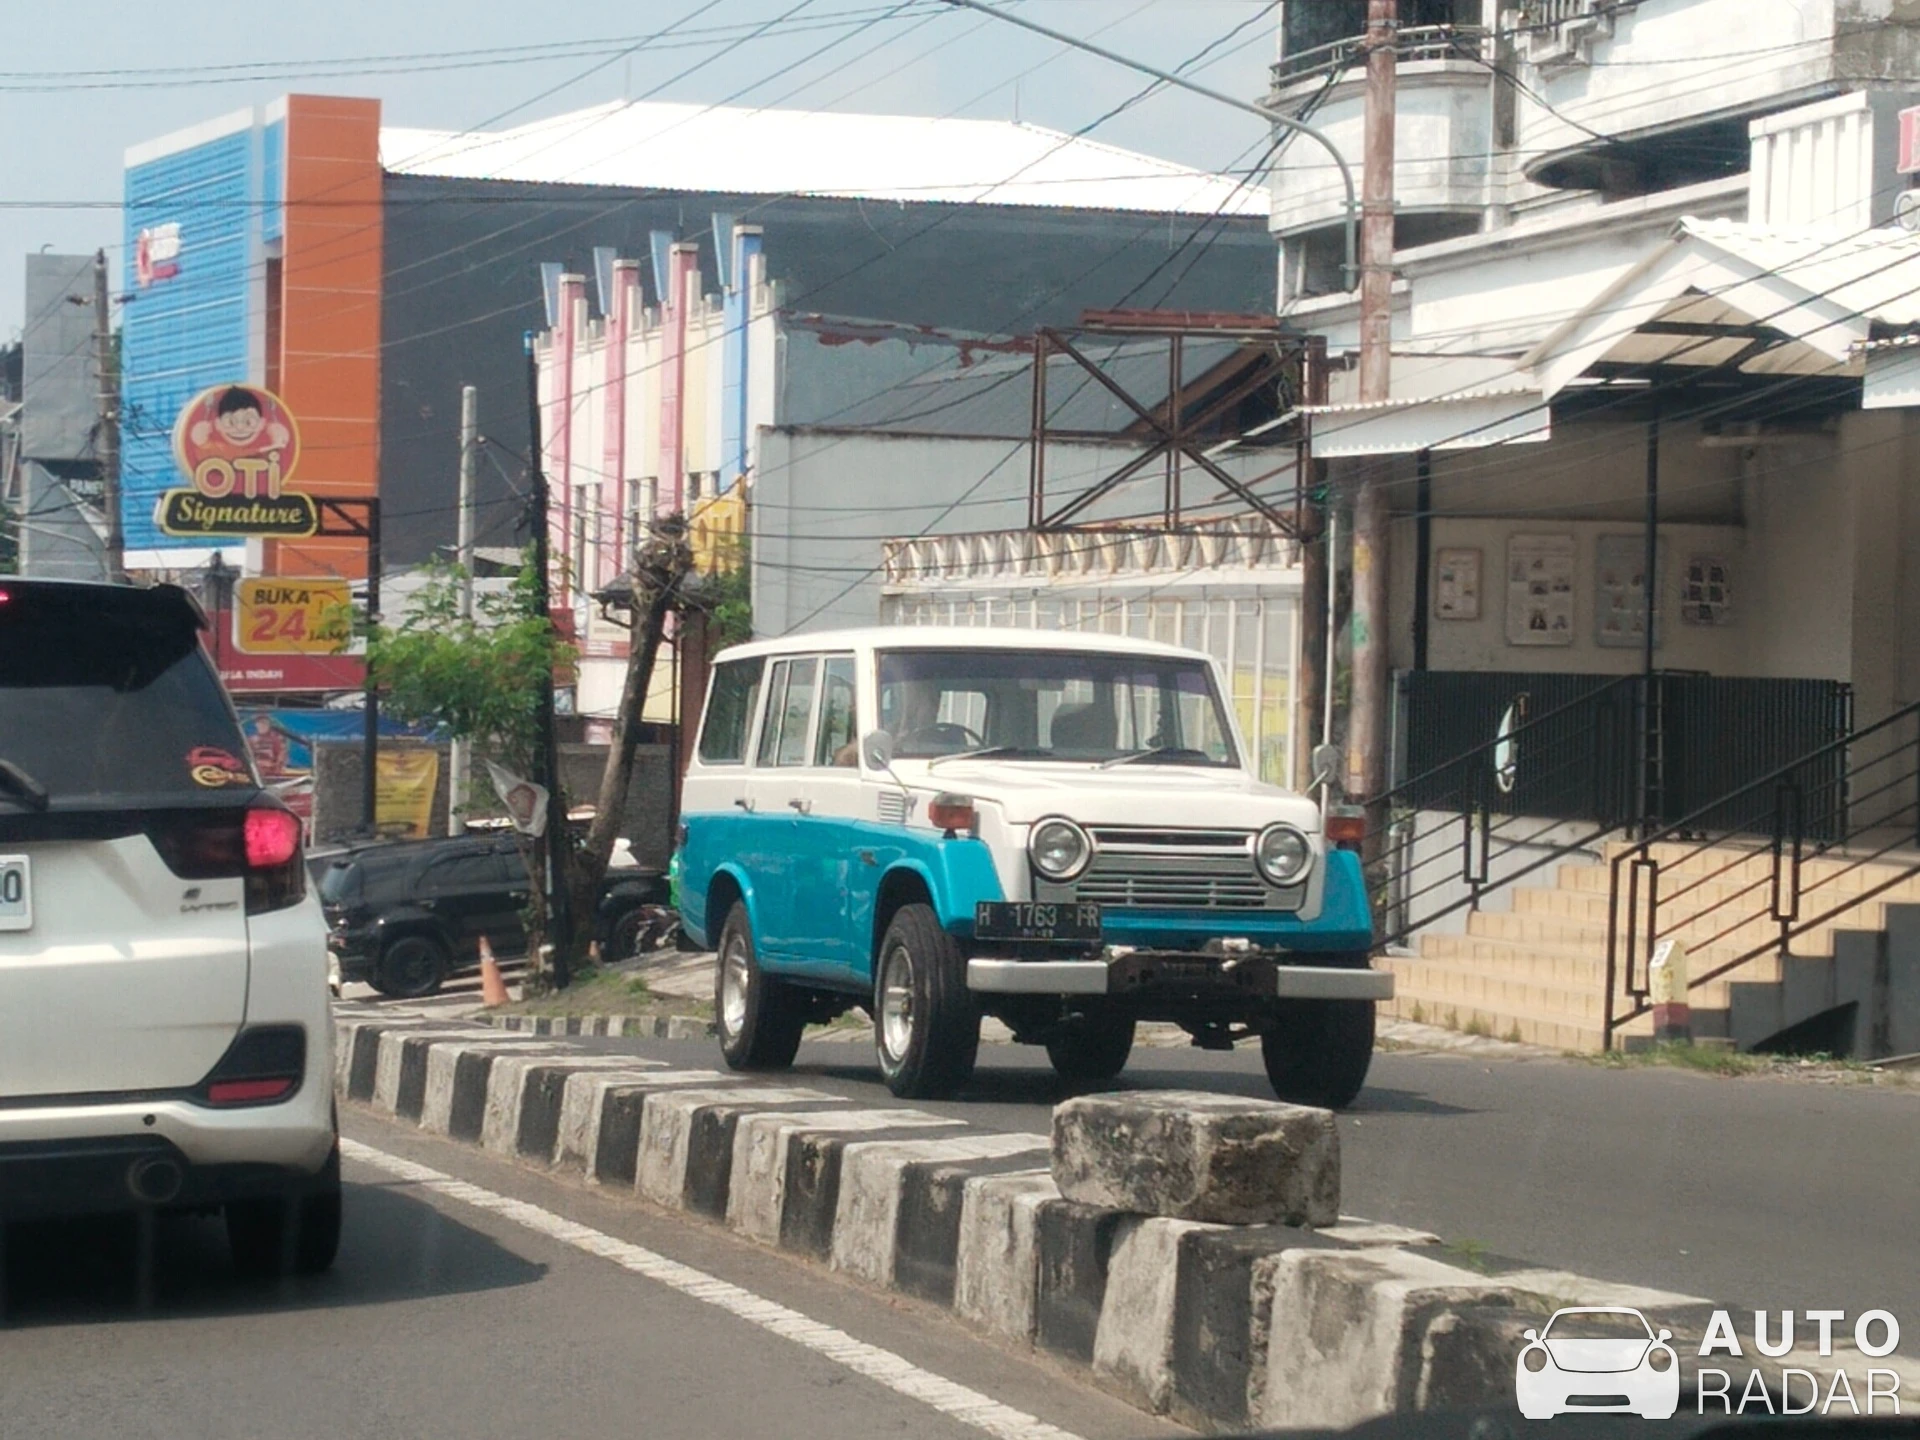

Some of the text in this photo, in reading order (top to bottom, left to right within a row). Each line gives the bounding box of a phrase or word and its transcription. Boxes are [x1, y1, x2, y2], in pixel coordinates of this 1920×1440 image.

[176, 495, 303, 530] Signature
[254, 588, 311, 605] BUKA
[251, 608, 307, 642] 24
[979, 904, 1099, 927] H 1763 FR
